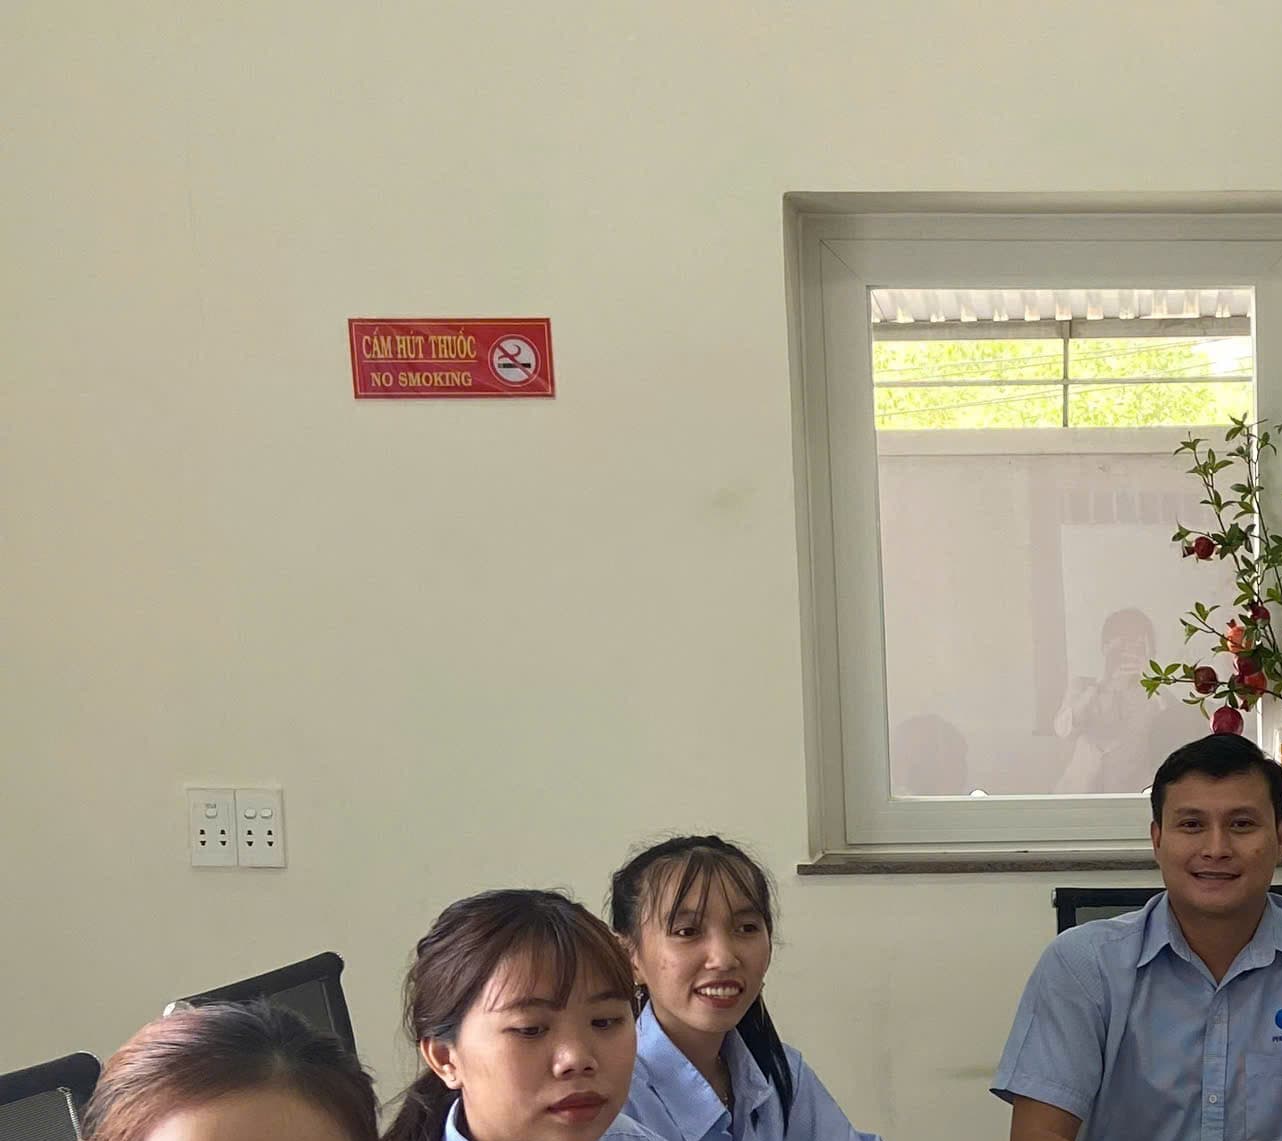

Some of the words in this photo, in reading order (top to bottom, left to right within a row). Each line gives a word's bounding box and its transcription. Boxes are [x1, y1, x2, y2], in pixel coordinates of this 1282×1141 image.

[396, 329, 425, 359] HÚT
[428, 326, 476, 359] THUỐC
[370, 372, 393, 387] NO
[399, 372, 473, 387] SMOKING
